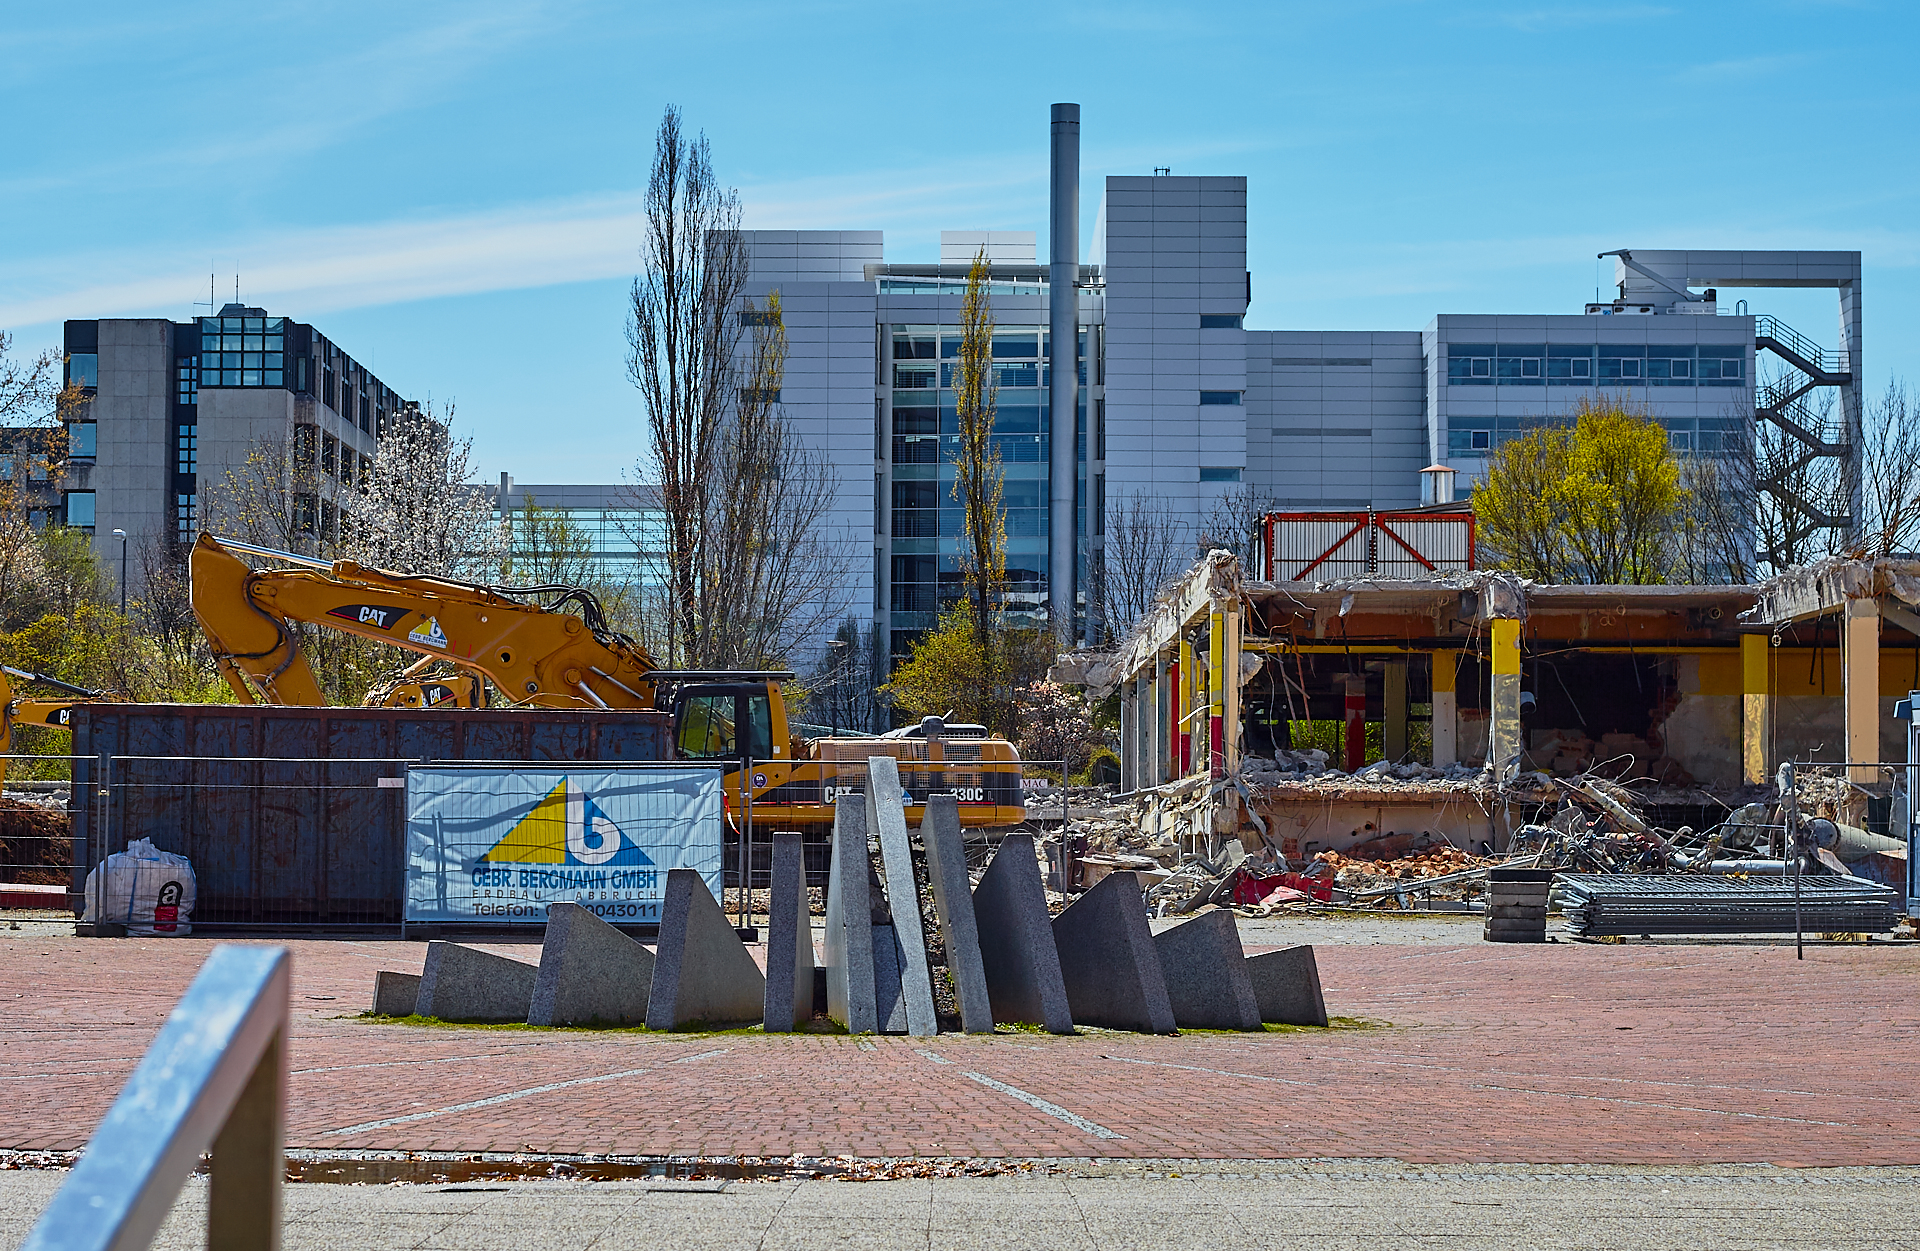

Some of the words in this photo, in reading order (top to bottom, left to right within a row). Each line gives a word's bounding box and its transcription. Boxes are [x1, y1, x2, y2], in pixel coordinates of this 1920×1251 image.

[358, 606, 387, 627] CAT
[430, 686, 441, 705] CAT
[1022, 779, 1046, 788] MAC
[472, 867, 515, 888] GEBR.
[520, 868, 606, 890] BERGMANN
[611, 869, 657, 890] GMBH
[472, 889, 541, 900] ERDBAU
[575, 890, 657, 901] ABBRUCH
[472, 902, 539, 917] Telefon:
